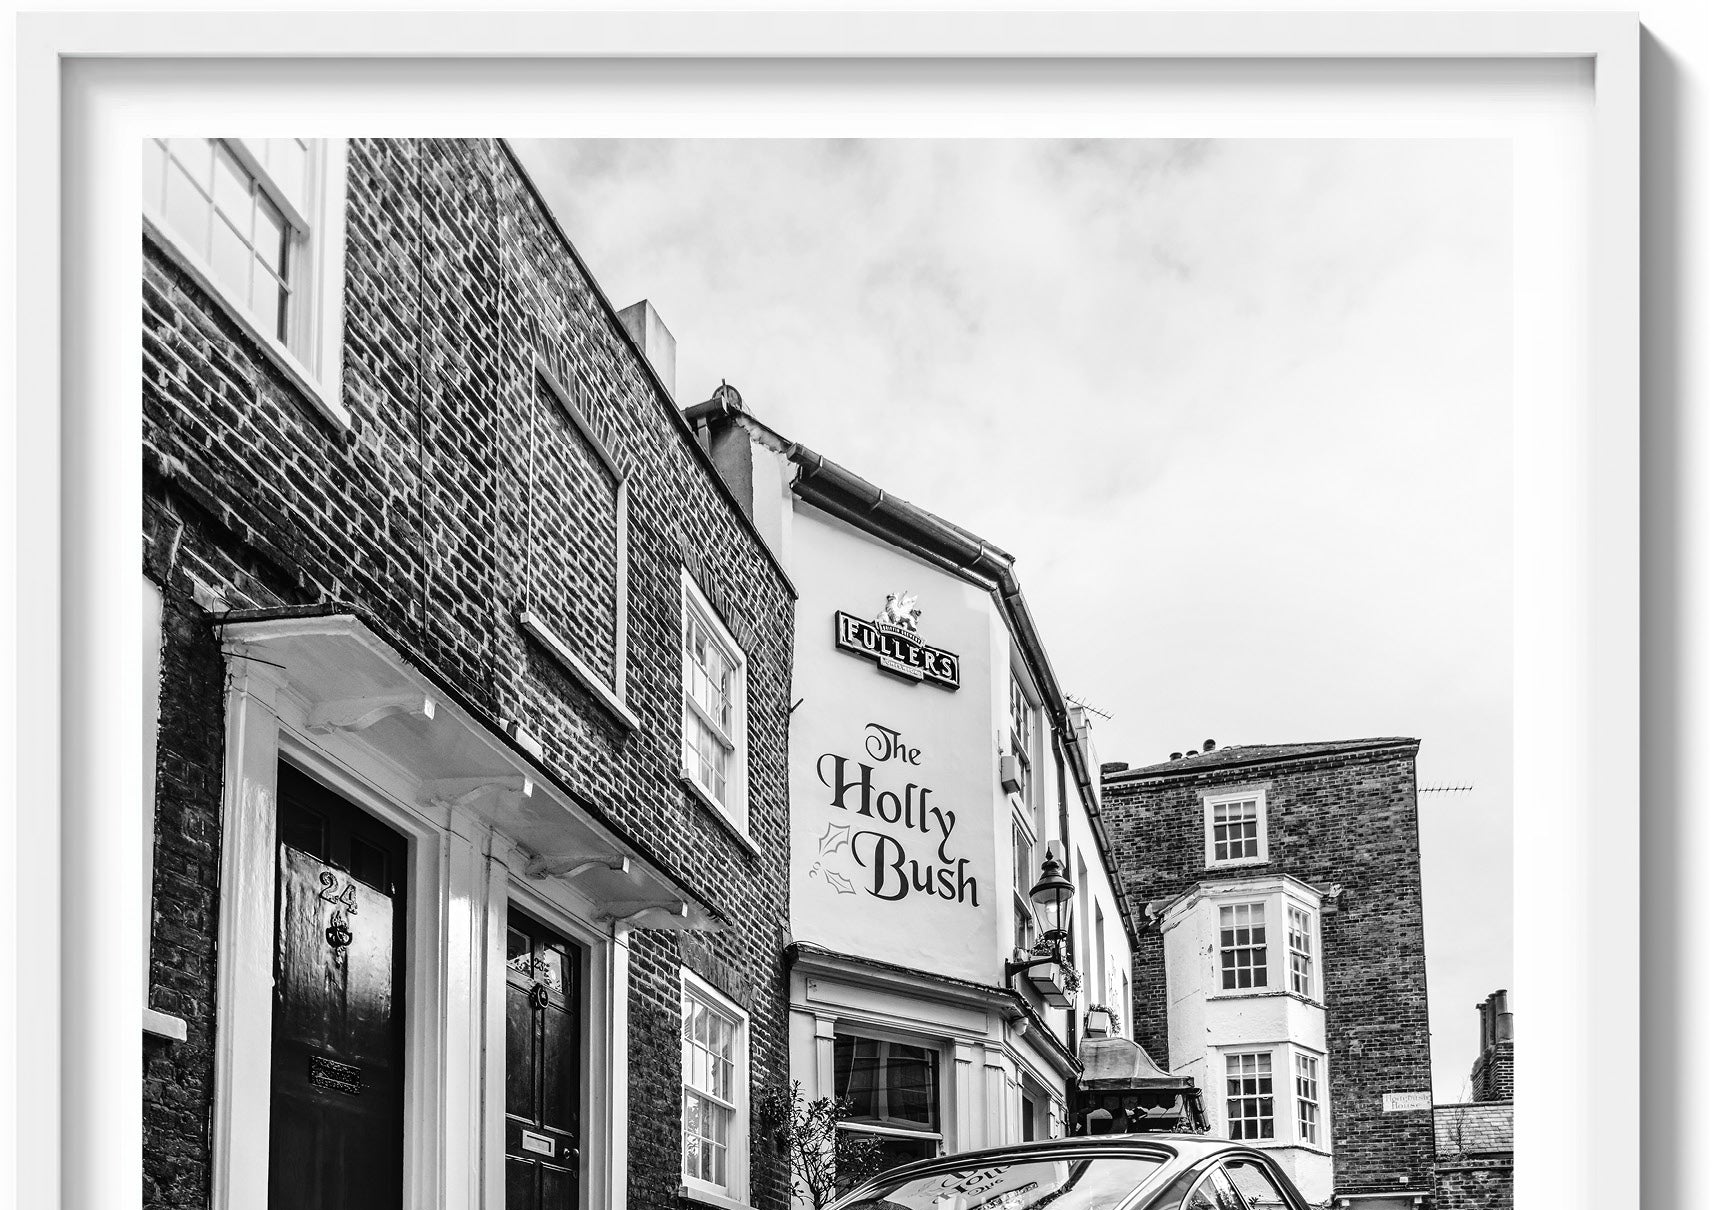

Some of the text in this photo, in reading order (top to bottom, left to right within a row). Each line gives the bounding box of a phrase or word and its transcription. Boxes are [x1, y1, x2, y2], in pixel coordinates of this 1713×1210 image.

[847, 620, 953, 678] FULLER'S
[865, 722, 921, 766] The
[816, 753, 956, 864] Holly
[318, 871, 358, 915] 24
[851, 830, 980, 907] Bush
